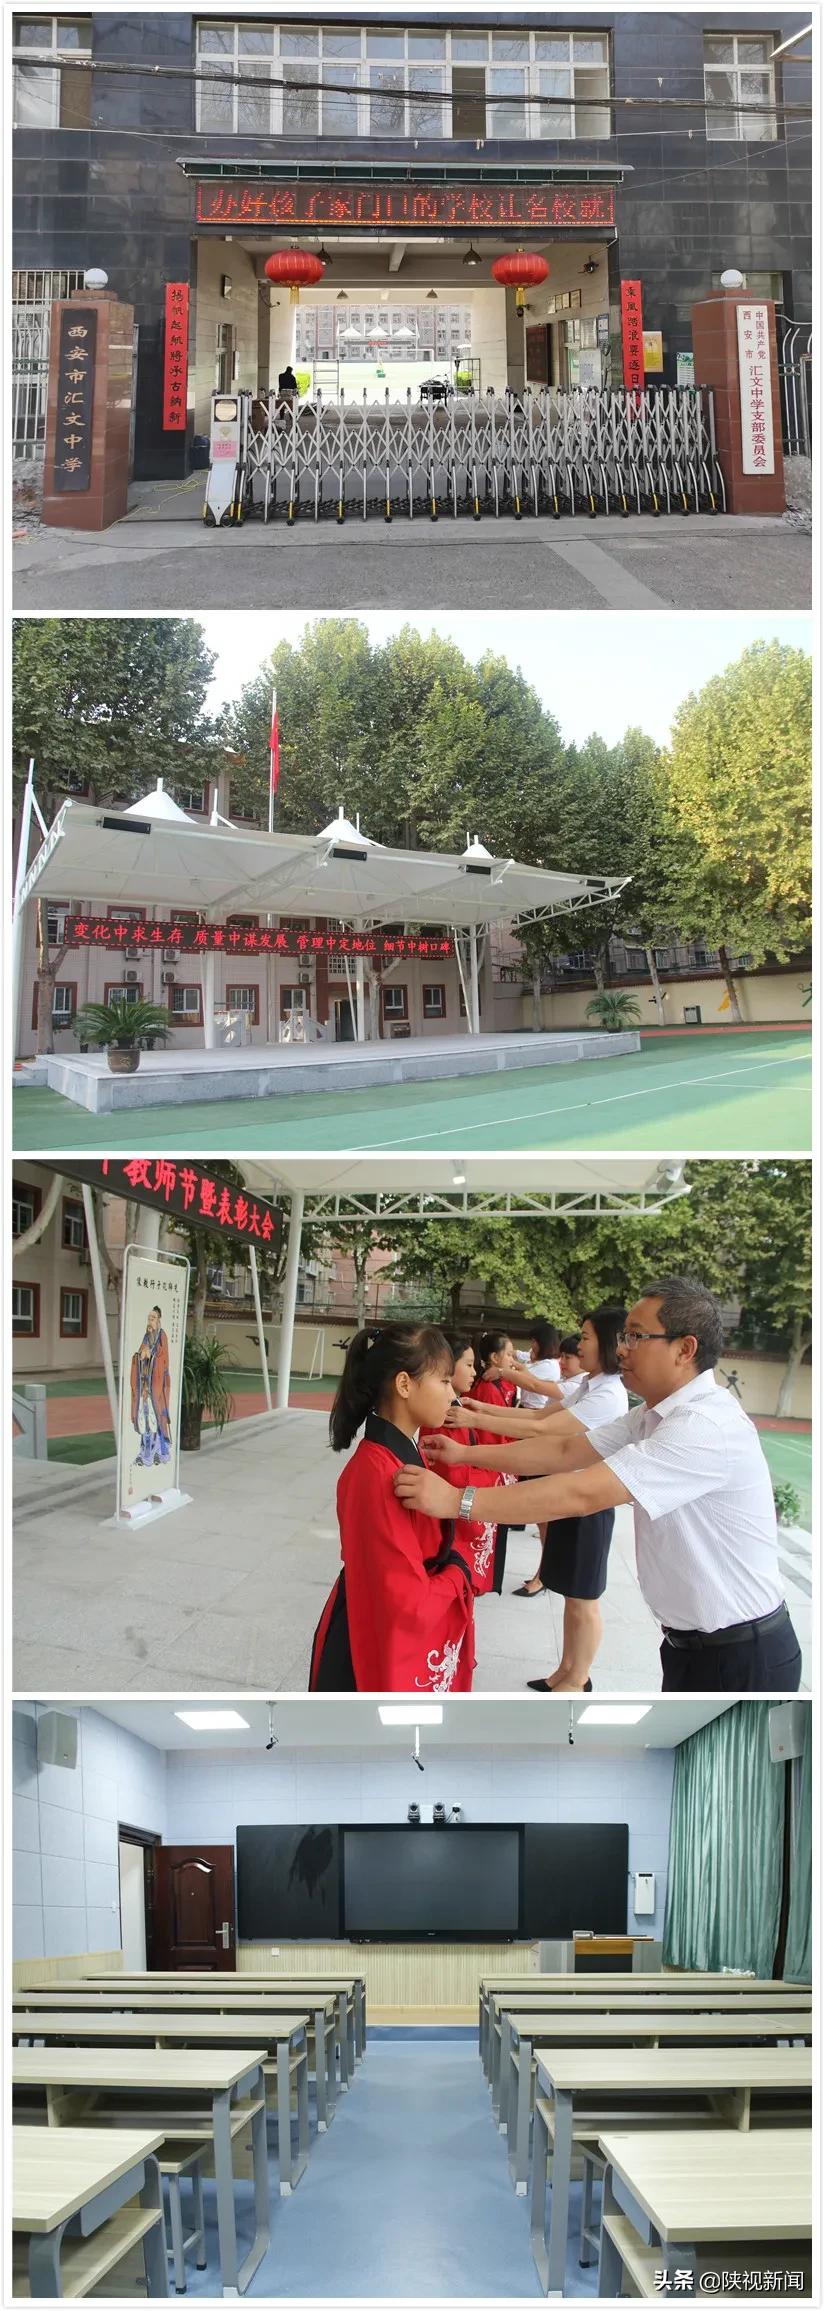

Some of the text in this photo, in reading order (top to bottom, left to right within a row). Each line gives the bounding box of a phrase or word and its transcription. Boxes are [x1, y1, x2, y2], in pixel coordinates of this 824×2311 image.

[743, 310, 753, 359] 西安市
[755, 311, 767, 360] 中国共产党
[63, 325, 88, 472] 西安市汇文中学
[749, 365, 767, 467] 汇文中学支部委员会
[74, 922, 451, 955] 变化中求生存 质量中谋发展 管理中定地位 细节中树口碑
[102, 1159, 274, 1240] 教师节暨表彰大会
